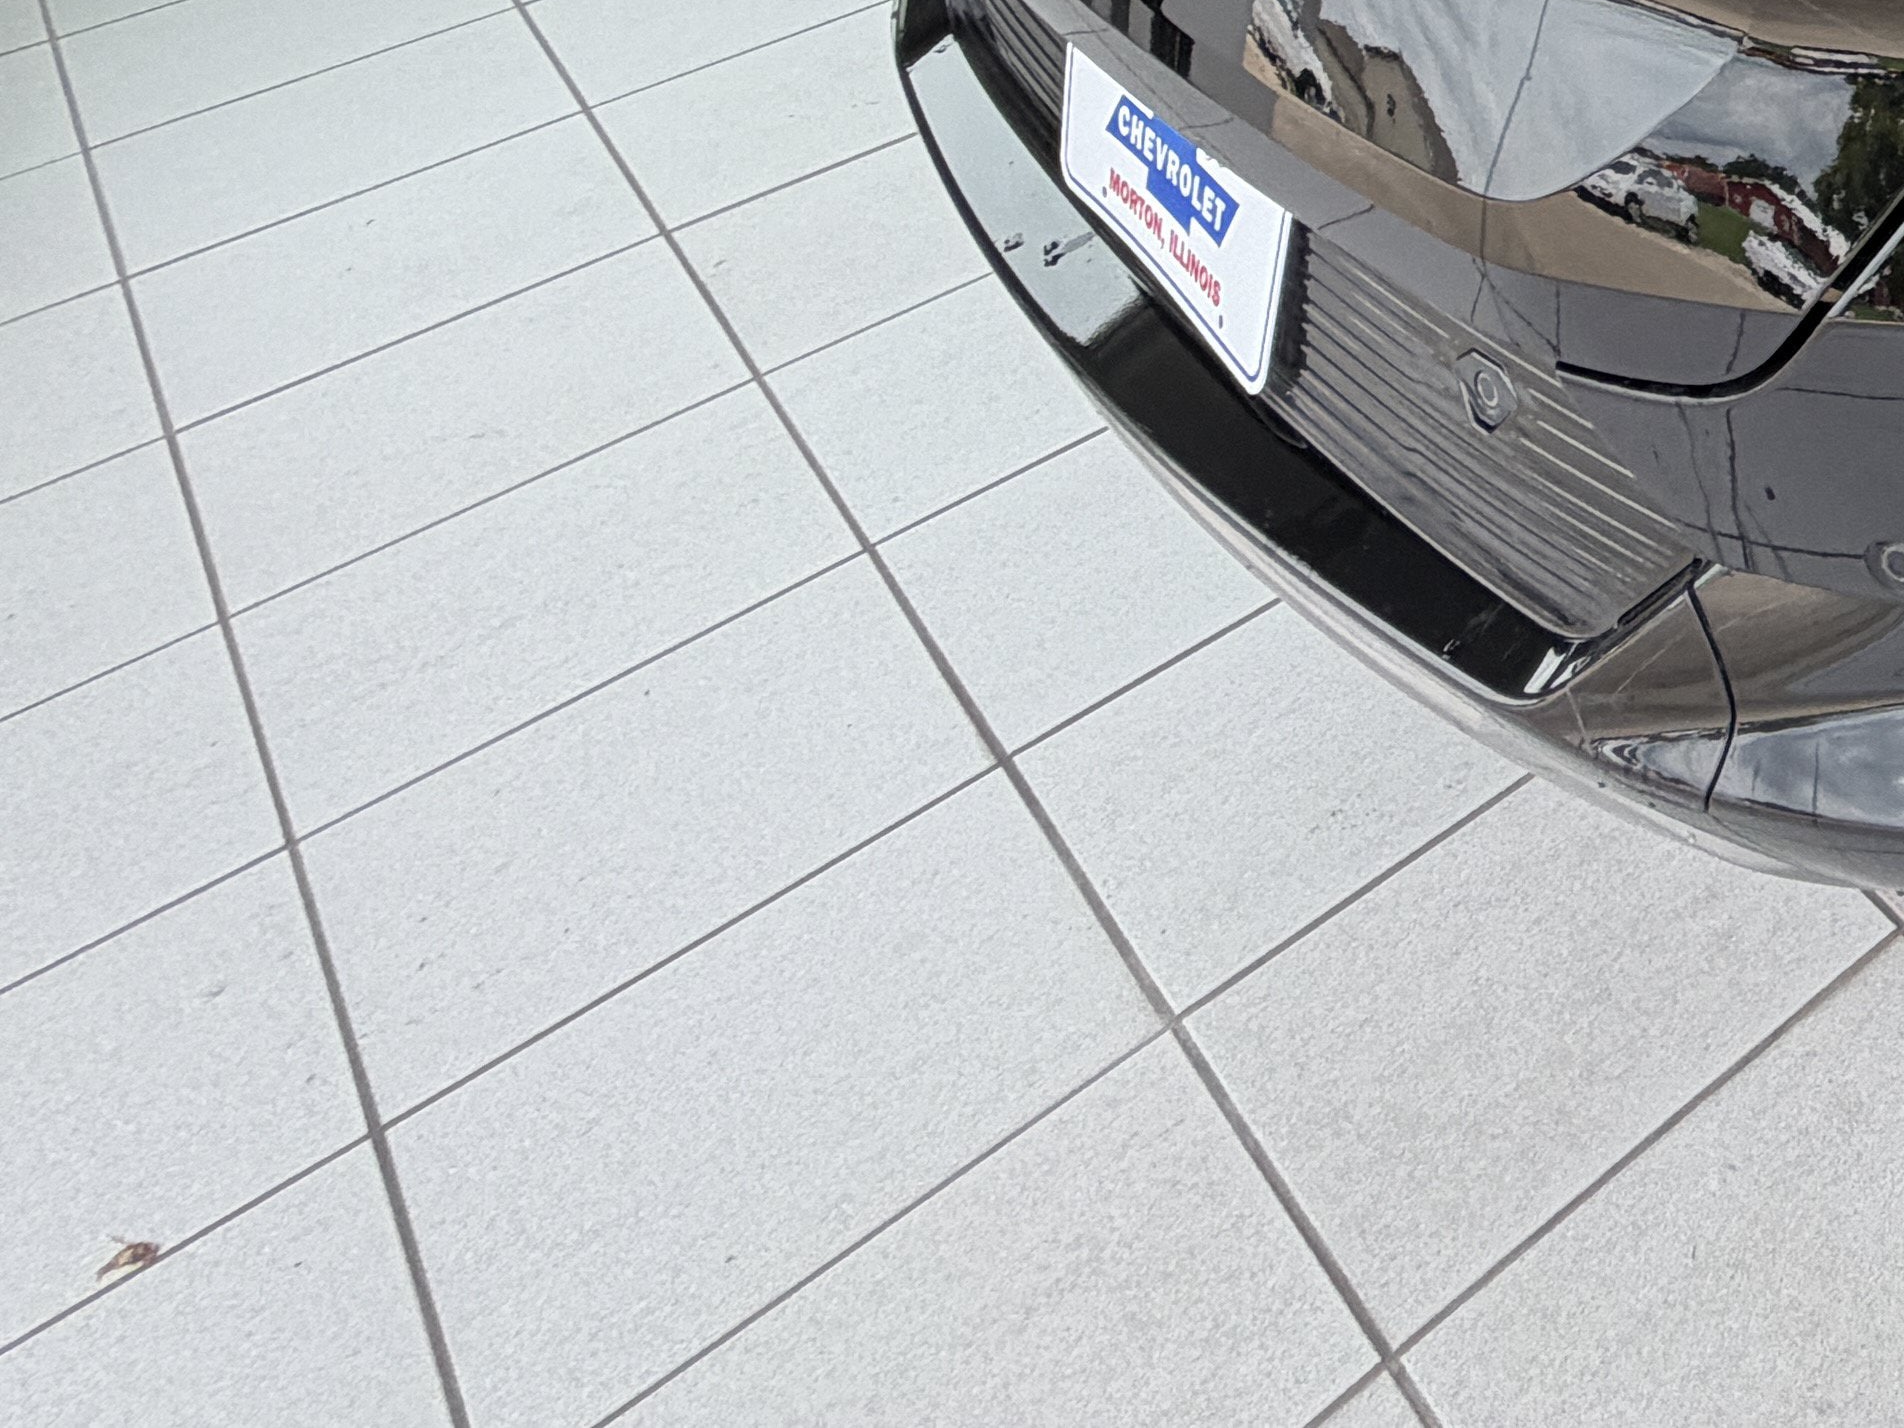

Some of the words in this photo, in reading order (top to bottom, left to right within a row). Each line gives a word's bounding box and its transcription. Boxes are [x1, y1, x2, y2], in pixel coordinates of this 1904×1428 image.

[1117, 105, 1227, 232] CHEVROLET
[1109, 167, 1165, 250] MORTON,
[1169, 230, 1222, 307] ILLINOIS
